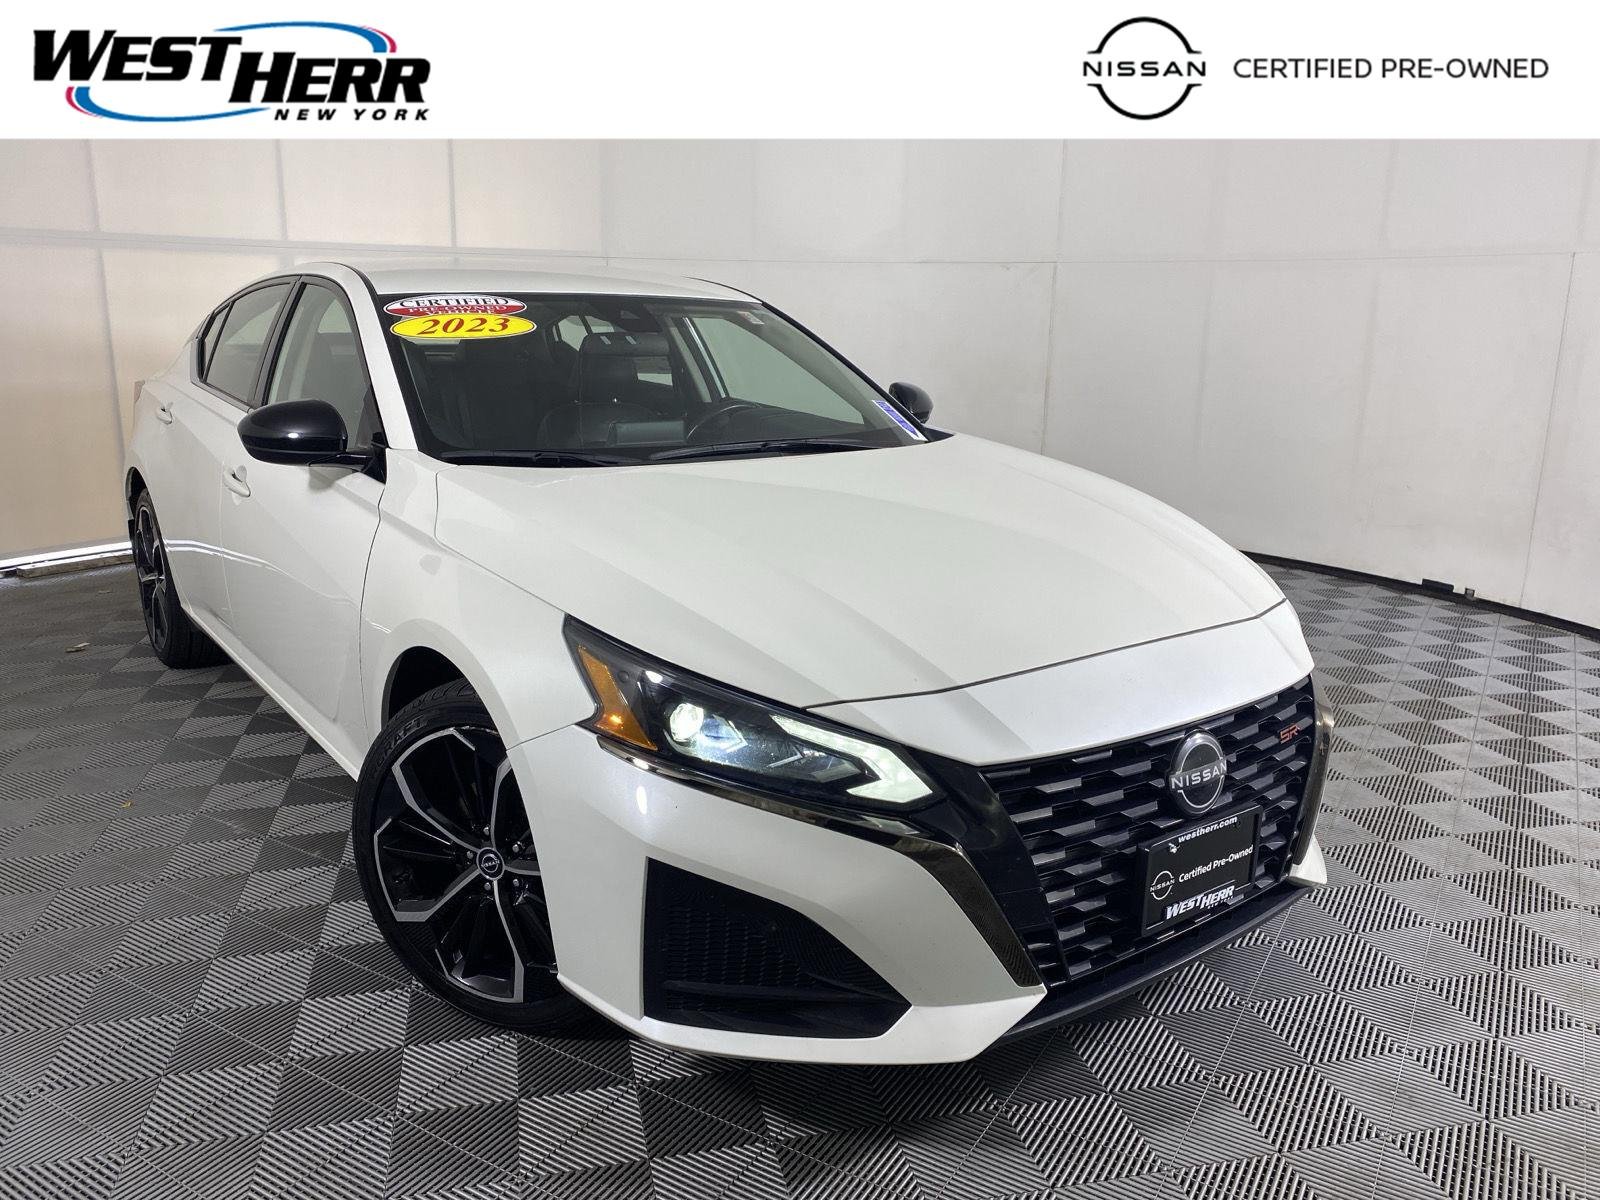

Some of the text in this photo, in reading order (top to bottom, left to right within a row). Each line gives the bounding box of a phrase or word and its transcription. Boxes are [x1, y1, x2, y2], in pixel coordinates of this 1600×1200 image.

[400, 296, 509, 308] CERTIFIED
[408, 305, 507, 313] PRE-OWNED
[417, 317, 511, 335] 2023
[1280, 724, 1301, 744] SR
[1171, 758, 1228, 789] NISSAN
[1178, 816, 1238, 843] westherr.com
[1178, 844, 1254, 883] Certified Pre-Owned
[1149, 879, 1176, 892] NISSAN
